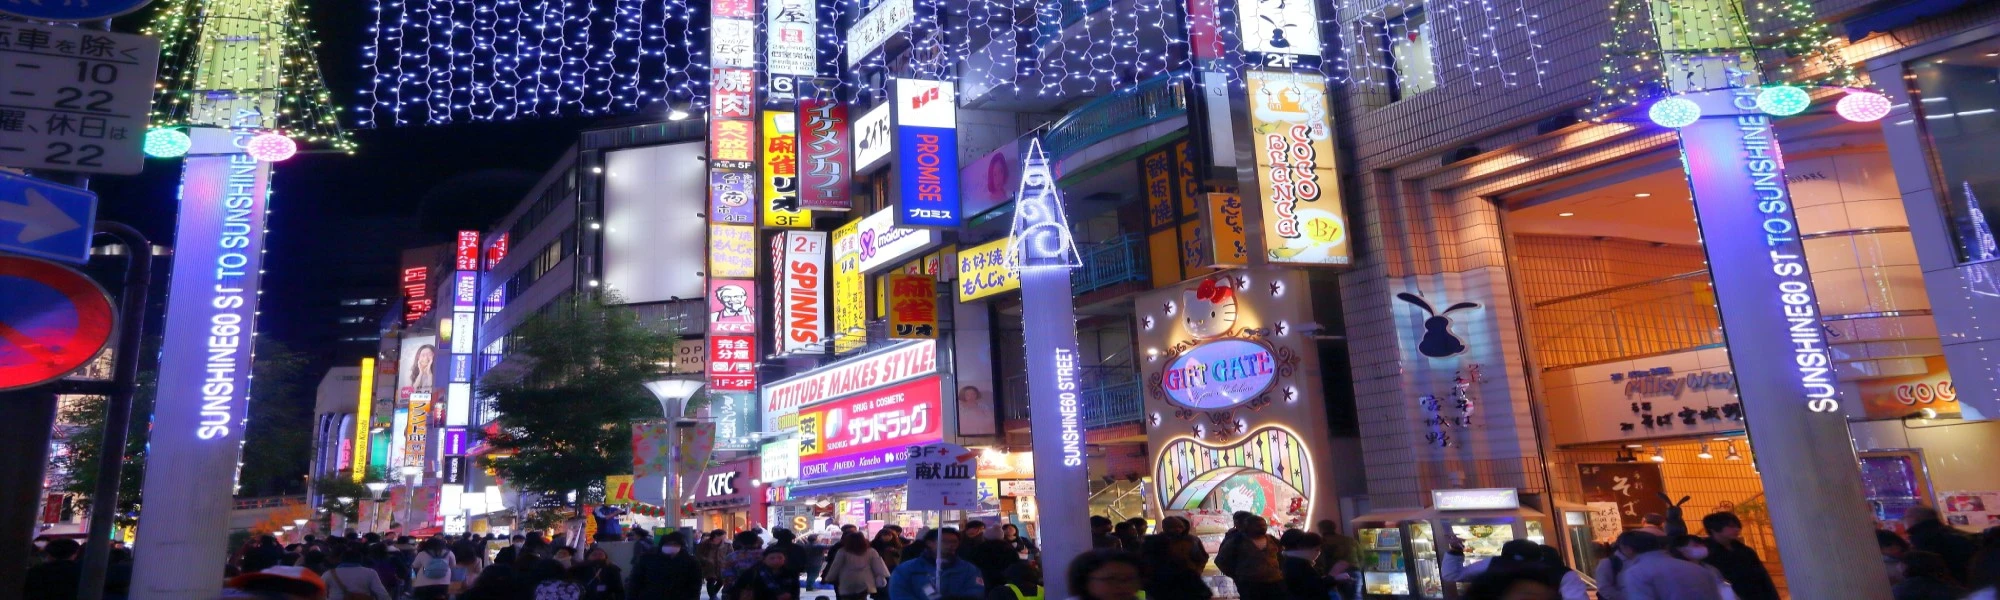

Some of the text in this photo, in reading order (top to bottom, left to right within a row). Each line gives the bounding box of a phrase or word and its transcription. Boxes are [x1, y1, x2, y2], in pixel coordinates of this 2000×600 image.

[77, 61, 118, 84] 10
[1267, 54, 1298, 67] 2F
[54, 87, 113, 112] 22
[714, 69, 752, 116] 焼肉
[45, 142, 104, 167] 22
[808, 101, 842, 198] イケメンカフェ
[1291, 124, 1318, 200] COCO
[917, 134, 942, 201] PROMISE
[1739, 115, 1787, 214] SUNSHINE
[220, 154, 258, 248] SUNSHINE
[909, 208, 951, 219] プロミス
[775, 215, 800, 226] 3F
[1763, 218, 1794, 246] TO
[795, 236, 817, 252] 2F
[216, 253, 247, 280] TO
[961, 247, 1004, 273] お好焼
[1771, 251, 1803, 276] ST
[212, 283, 243, 309] ST
[962, 270, 1005, 296] もんじゃ
[790, 260, 818, 343] SPINNS
[893, 276, 934, 322] 麻雀
[715, 323, 752, 331] KFC
[897, 324, 933, 336] リオ
[680, 347, 704, 355] OP
[717, 339, 749, 349] 完全
[1779, 281, 1838, 413] SUNSHINE60
[197, 313, 241, 440] SUNSHINE60
[768, 378, 825, 413] ATTITUDE
[828, 366, 877, 395] MAKES
[882, 343, 935, 387] STYLE!
[1163, 351, 1273, 391] GIFT GATE
[1625, 376, 1686, 399] Milky
[1687, 371, 1735, 393] Way
[852, 393, 905, 413] DRUG & COSMETIC
[1056, 347, 1081, 467] SUNSHINE60 STREET
[800, 416, 816, 453] 薬
[848, 402, 927, 446] サンドラッグ
[827, 440, 848, 450] SUNDRUG
[910, 446, 936, 458] 3F
[802, 462, 829, 477] COSMETIC
[859, 456, 881, 467] Kanebo
[915, 462, 970, 480] 献血
[707, 471, 736, 497] KFC
[1612, 475, 1638, 516] そば
